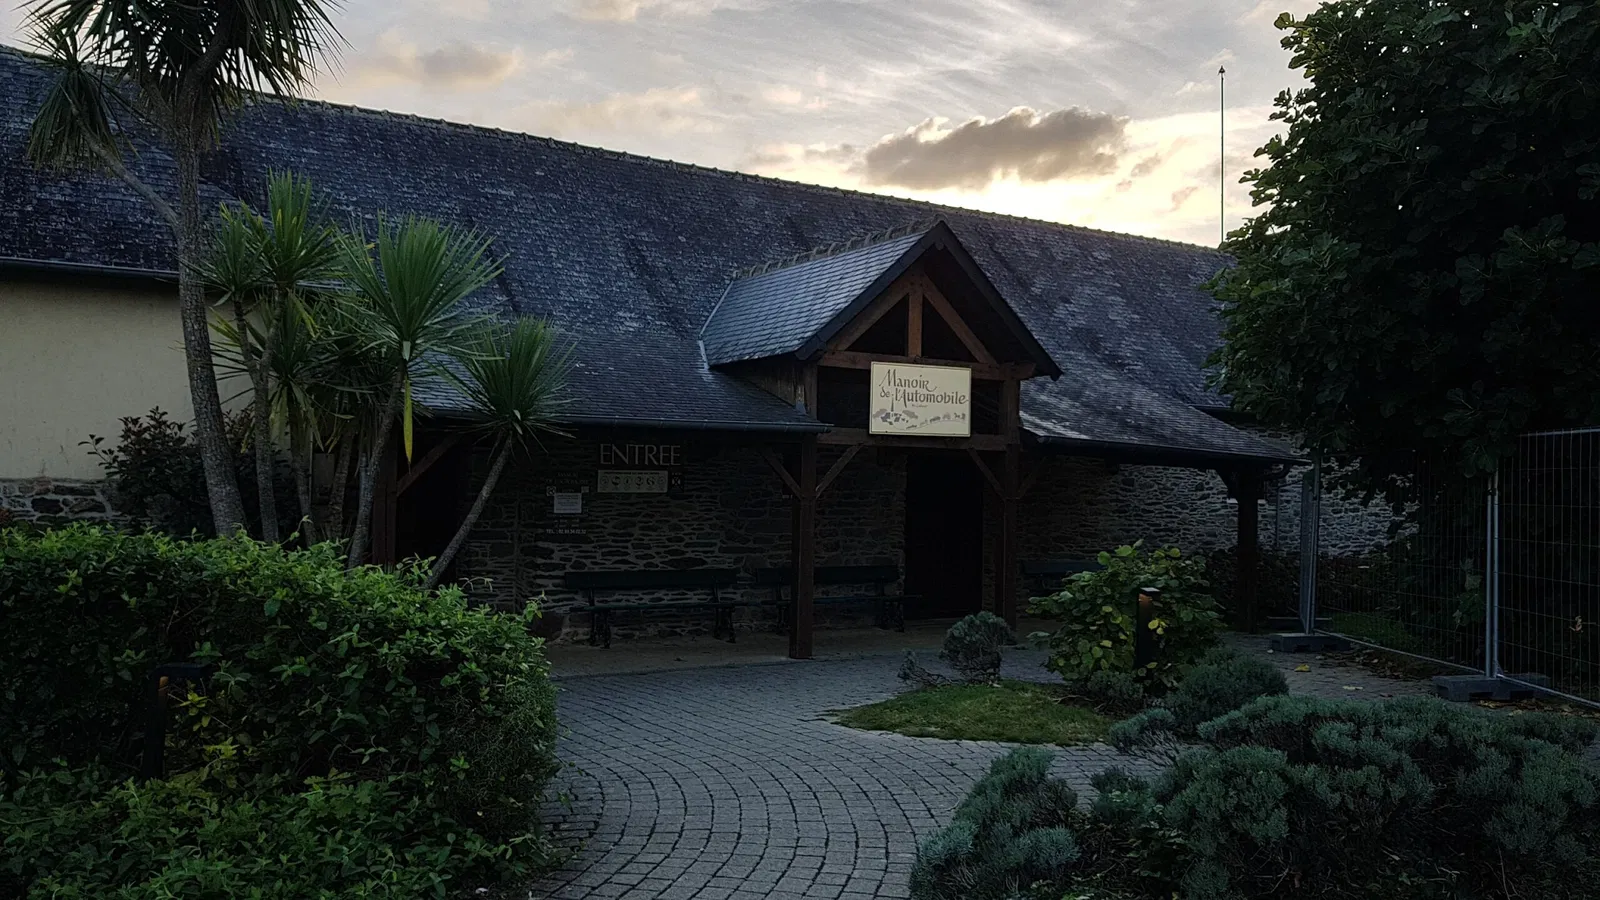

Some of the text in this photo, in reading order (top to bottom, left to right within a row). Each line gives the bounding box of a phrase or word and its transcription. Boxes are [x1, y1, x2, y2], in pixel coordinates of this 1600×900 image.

[878, 368, 938, 392] Manoir
[879, 386, 969, 408] de l'Automobile
[600, 443, 681, 466] ENTREE
